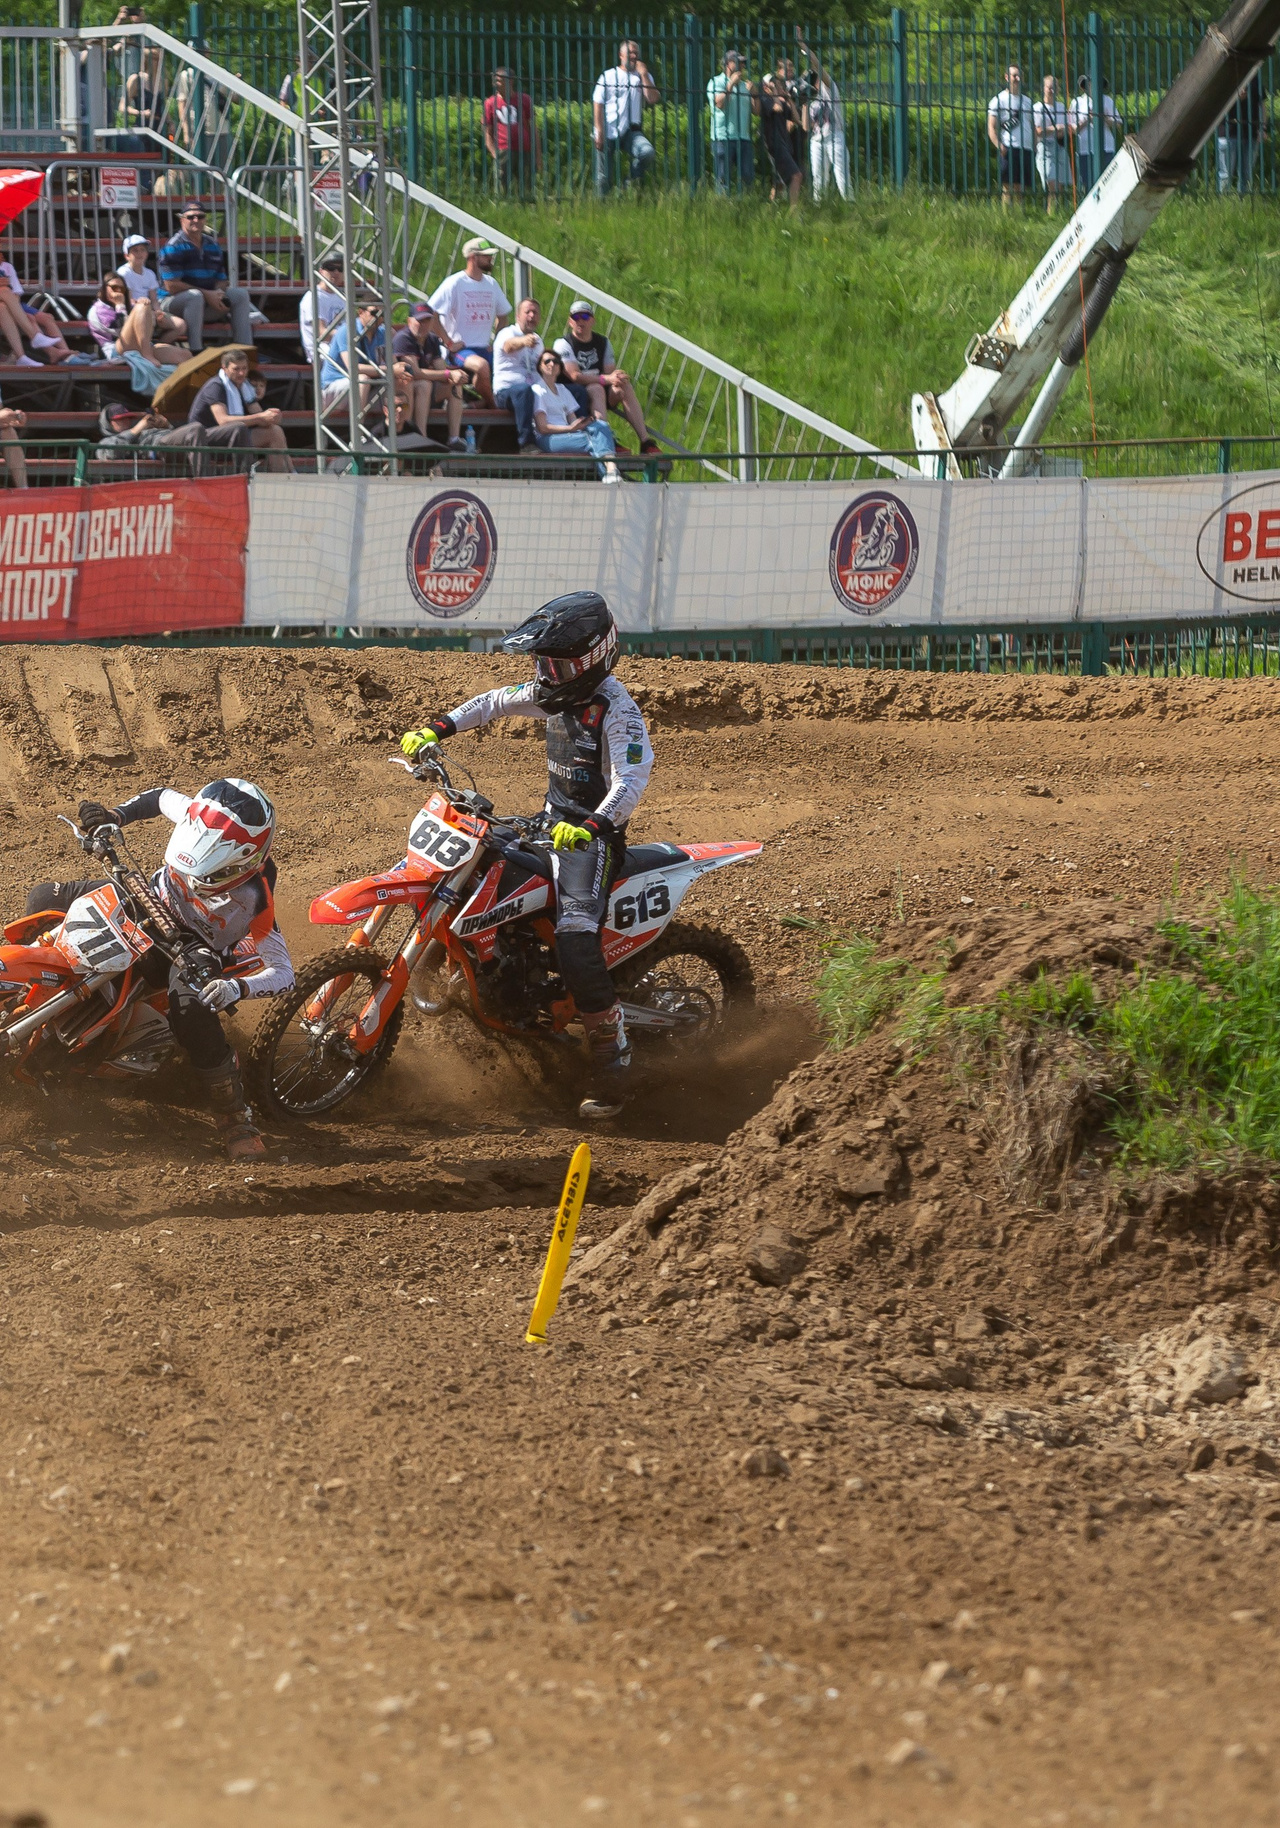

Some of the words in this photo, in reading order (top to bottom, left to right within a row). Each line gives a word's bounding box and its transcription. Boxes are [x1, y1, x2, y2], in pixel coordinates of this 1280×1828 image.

[423, 574, 476, 593] МФМС
[846, 573, 894, 592] МФМС
[572, 768, 590, 782] 125
[177, 853, 194, 866] BELL
[410, 820, 472, 867] 613
[126, 877, 170, 934] RENTHAL
[460, 896, 524, 936] ПРИМОРЬЕ
[614, 885, 671, 930] 613
[65, 905, 127, 967] 711
[558, 1171, 581, 1242] ACERBIS
